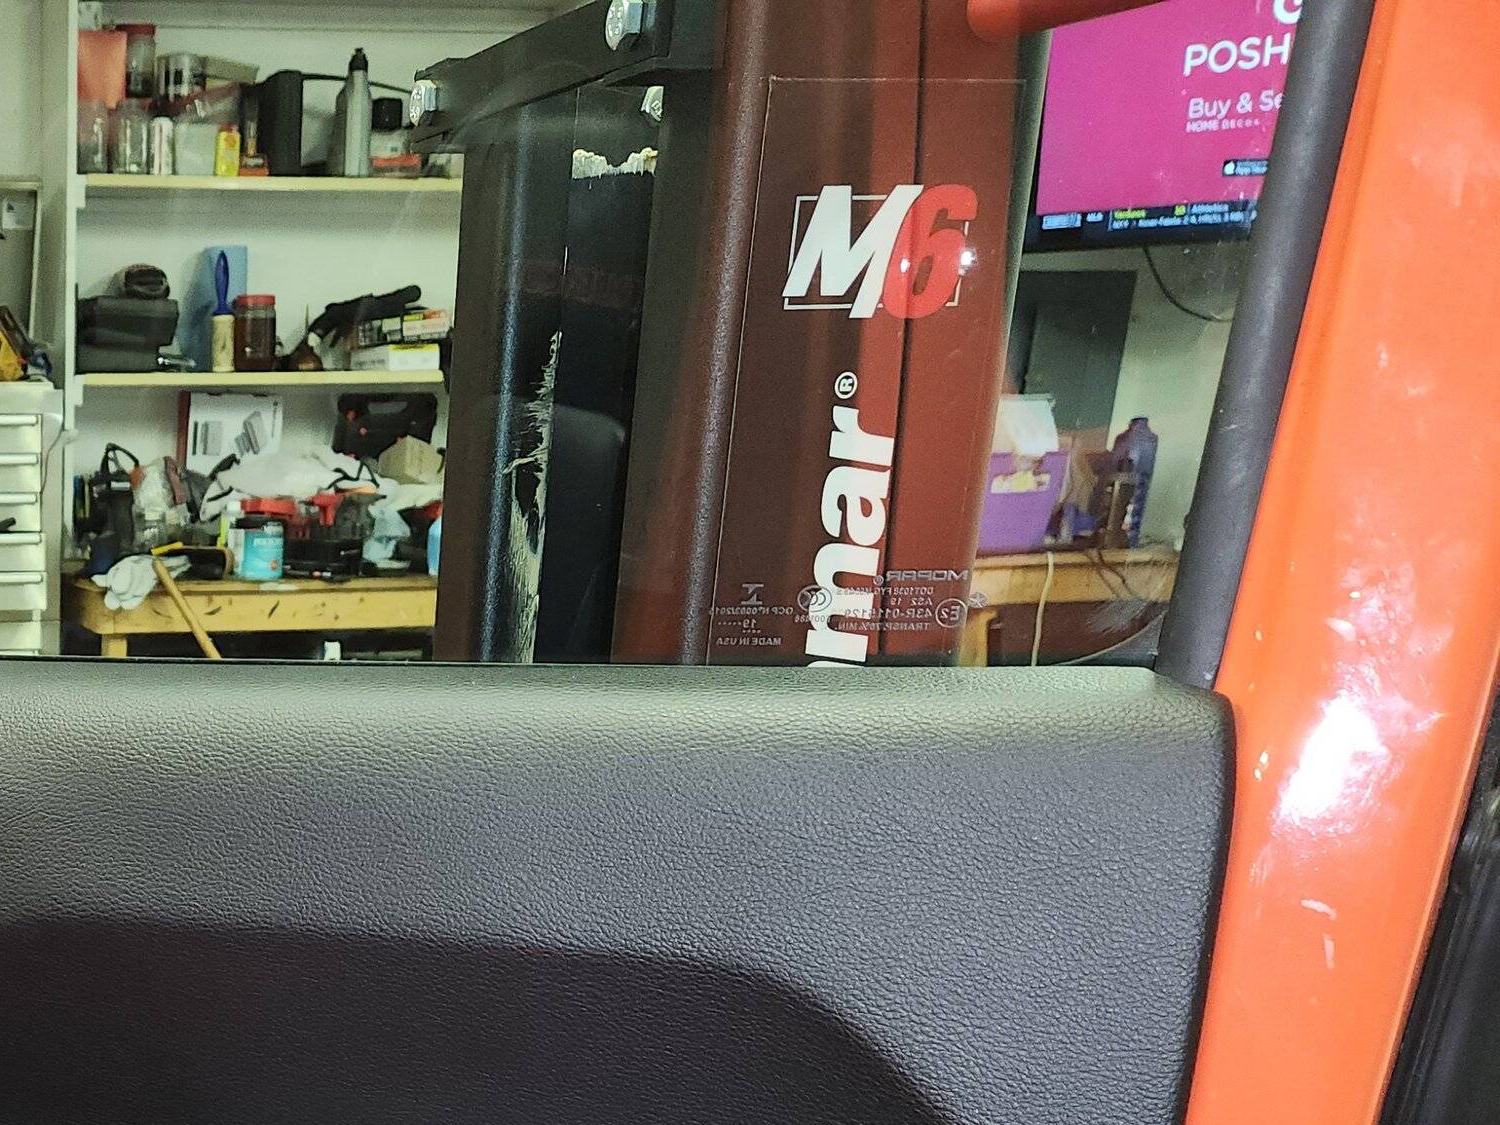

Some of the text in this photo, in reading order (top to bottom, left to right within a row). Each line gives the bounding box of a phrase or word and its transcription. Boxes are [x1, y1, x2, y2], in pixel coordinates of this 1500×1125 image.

[1183, 32, 1292, 77] POSH
[1187, 89, 1284, 119] Buy & Se
[1186, 119, 1220, 133] HOME
[782, 183, 979, 319] M6
